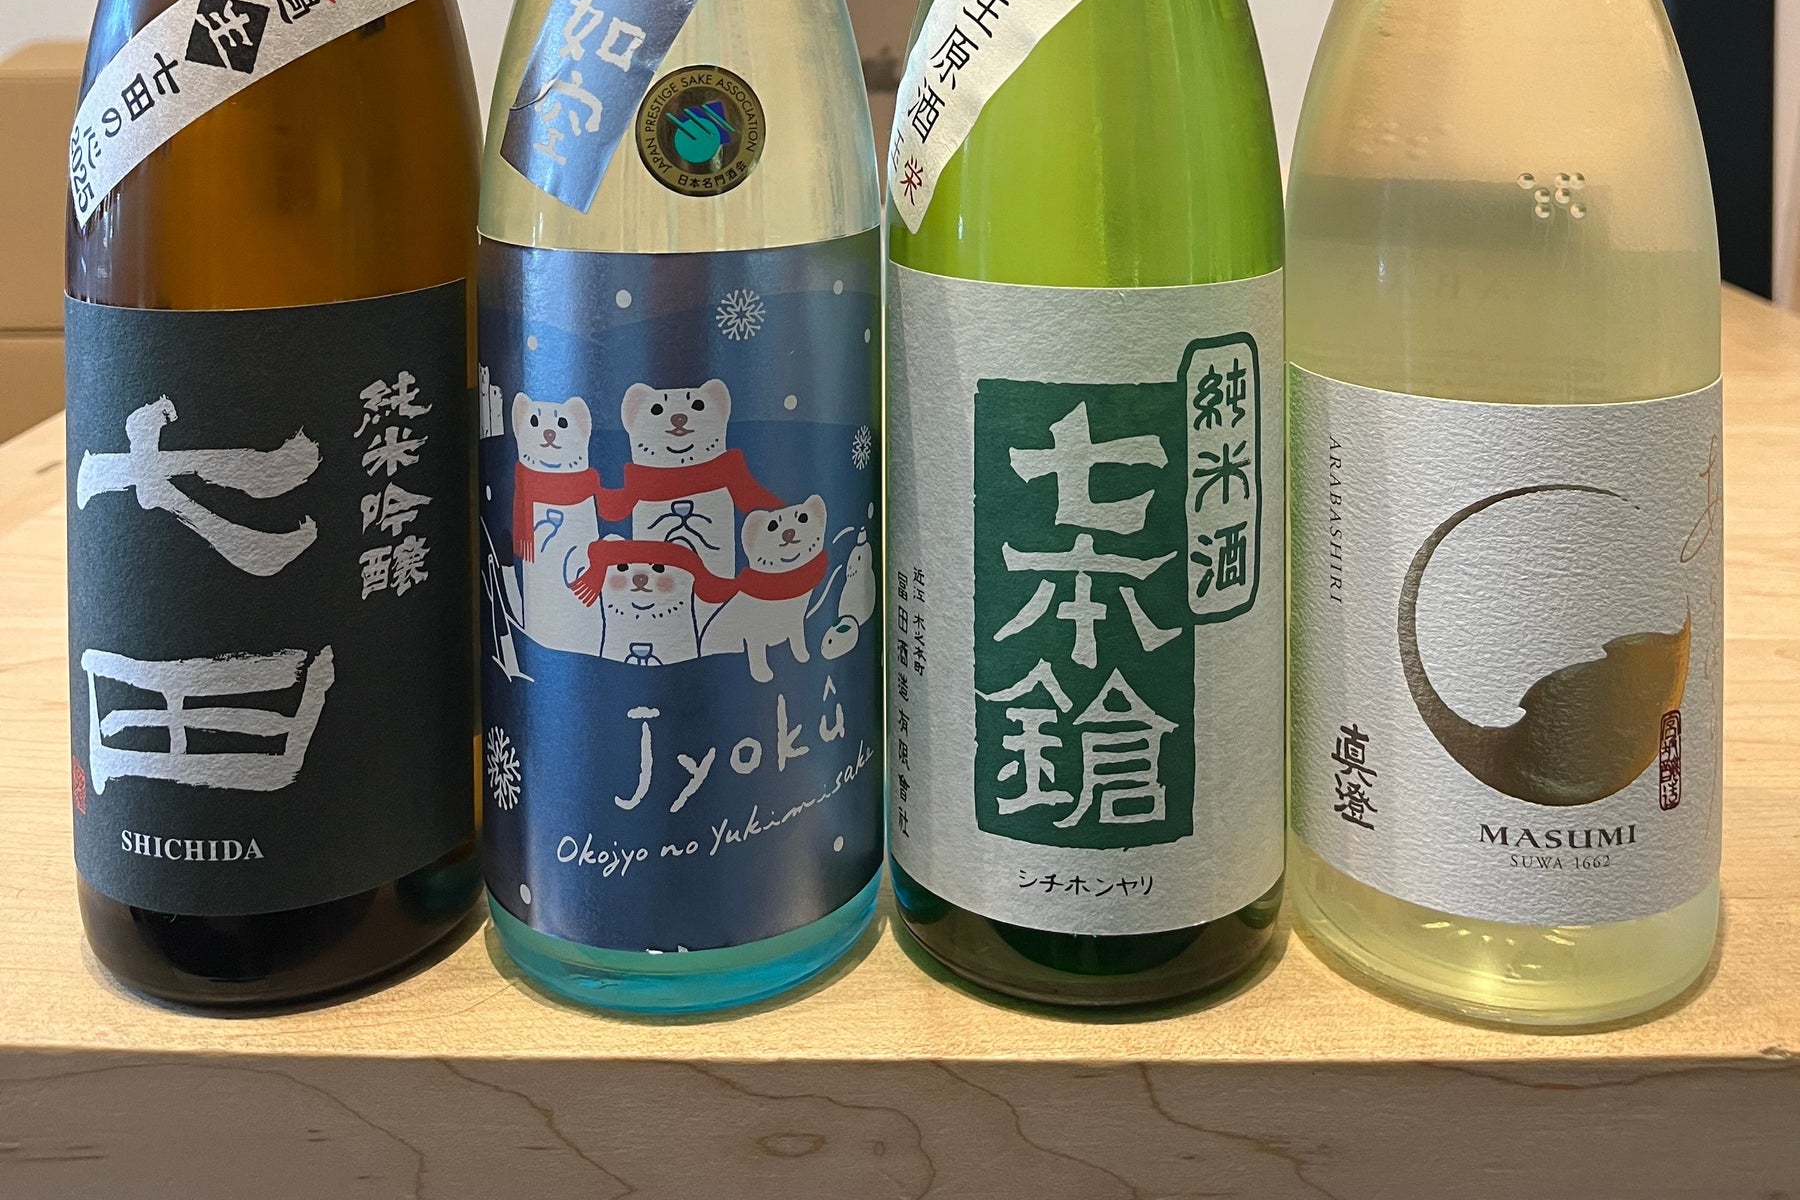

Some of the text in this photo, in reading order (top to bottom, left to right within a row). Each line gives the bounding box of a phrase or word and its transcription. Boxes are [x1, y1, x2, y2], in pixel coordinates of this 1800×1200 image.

[644, 73, 759, 174] JAPAN PRESTIGE SAKE ASSOCIATION
[677, 160, 747, 189] 日本名門酒会
[1190, 357, 1252, 599] 純米酒
[1329, 435, 1343, 604] ARABASHIRI
[76, 393, 336, 796] 七田
[120, 828, 265, 862] SHICHIDA
[556, 832, 649, 878] Okojyo
[660, 839, 700, 858] no
[1479, 823, 1637, 849] MASUMI
[1509, 853, 1611, 870] SUWA 1662
[1018, 867, 1154, 898] シチホンヤリ
